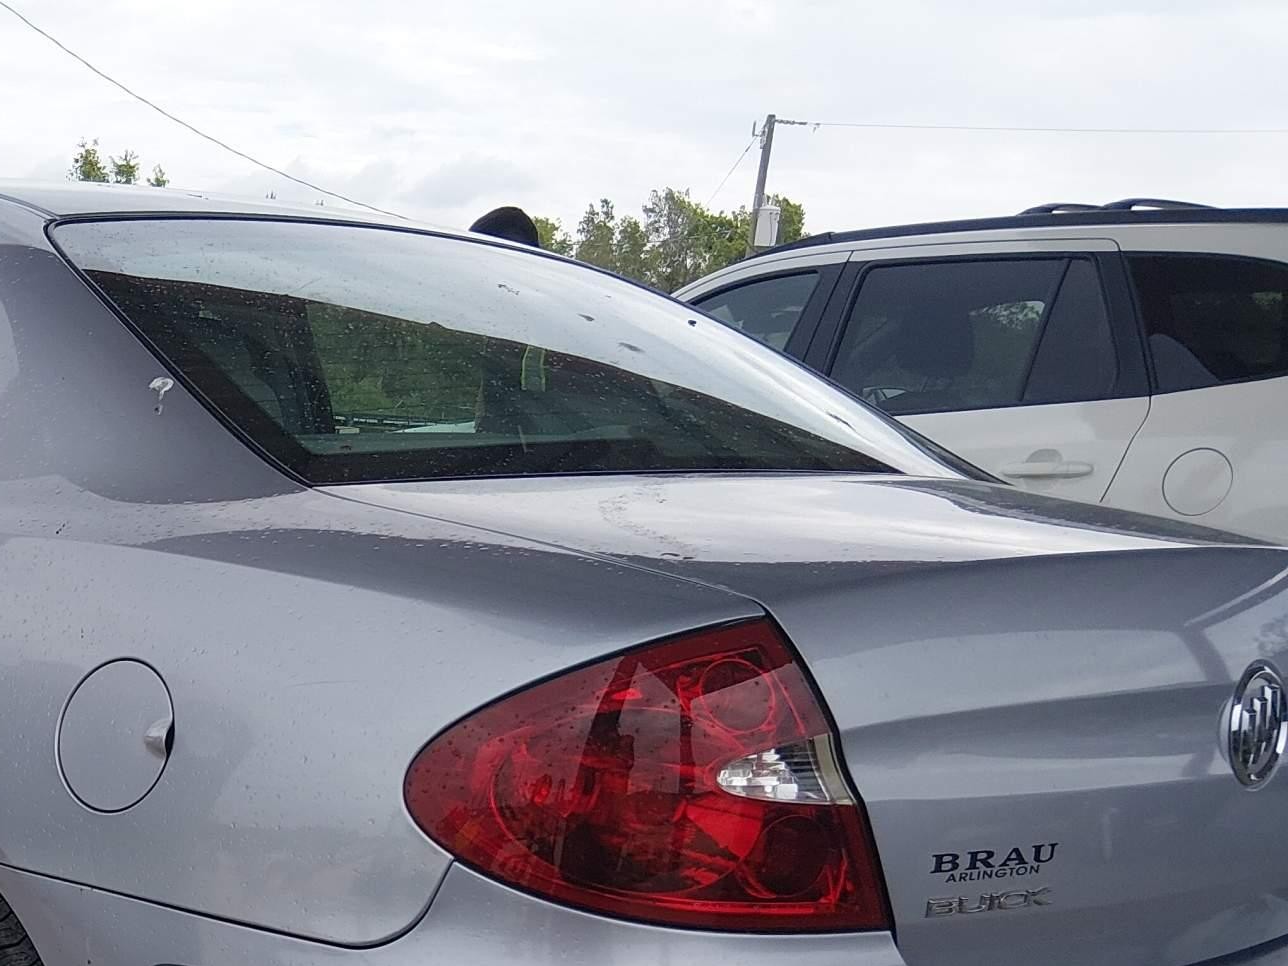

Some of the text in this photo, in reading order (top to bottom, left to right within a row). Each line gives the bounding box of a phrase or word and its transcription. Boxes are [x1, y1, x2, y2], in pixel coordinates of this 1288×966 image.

[929, 842, 1059, 874] BRAU
[945, 864, 1041, 883] ARLINGTON
[924, 886, 1054, 918] BUICK
